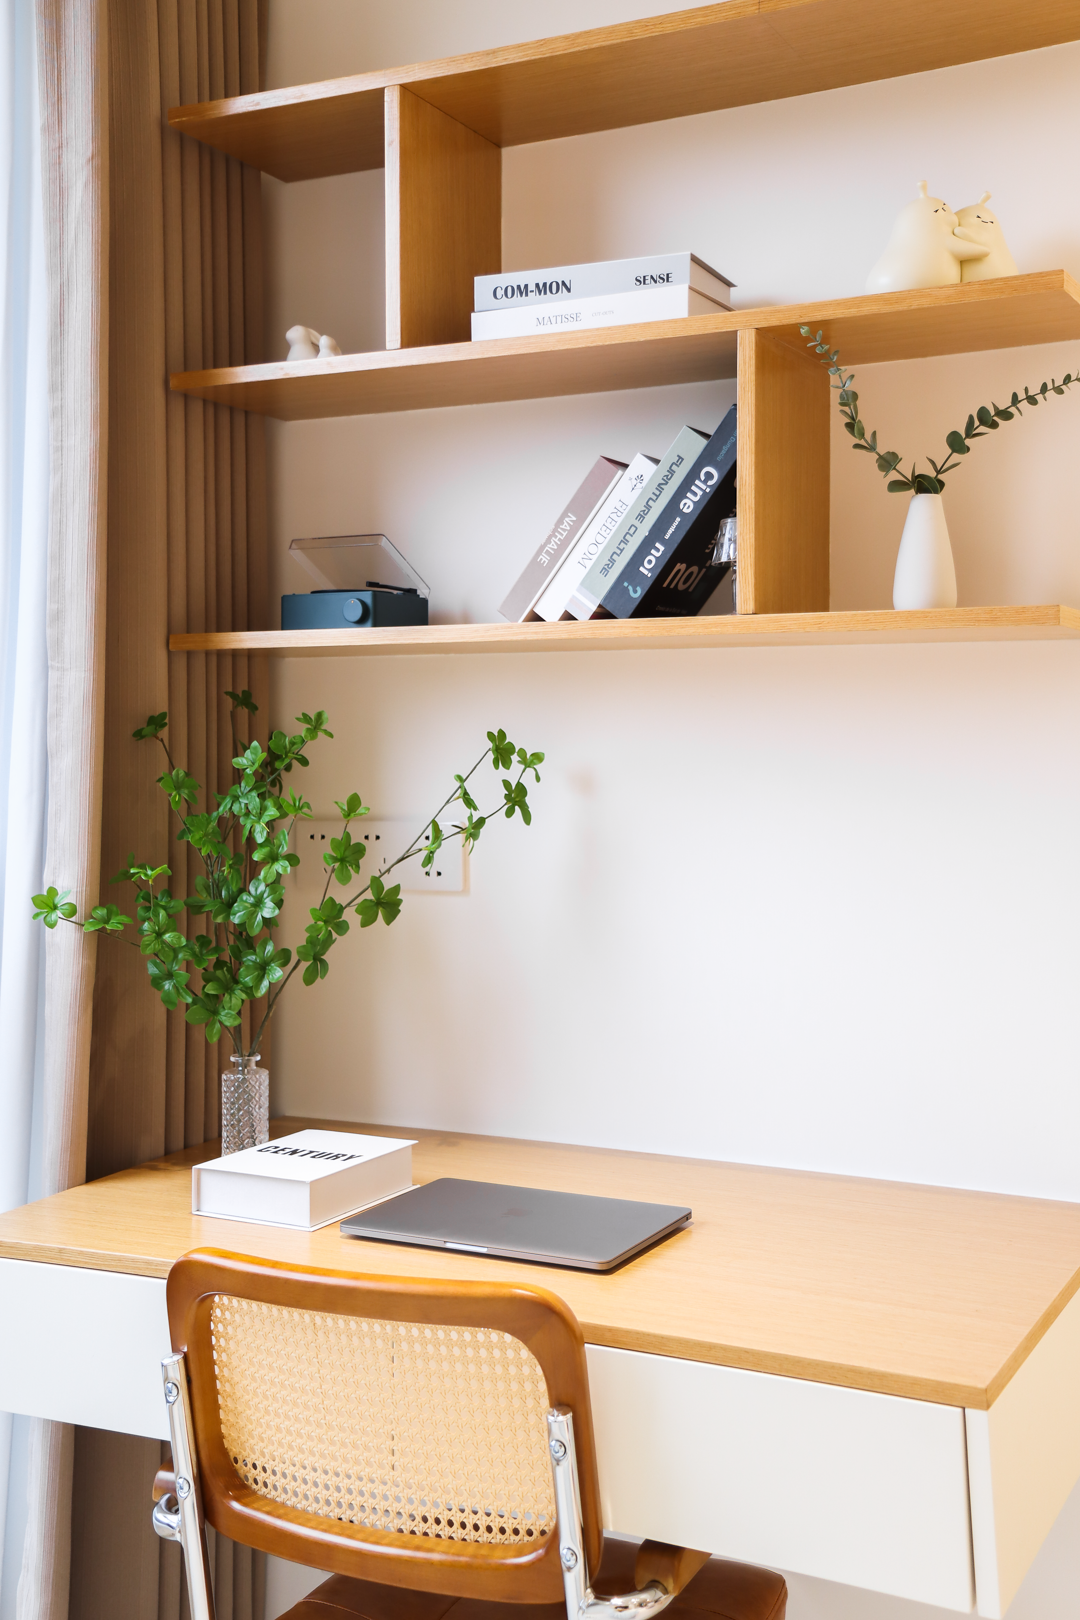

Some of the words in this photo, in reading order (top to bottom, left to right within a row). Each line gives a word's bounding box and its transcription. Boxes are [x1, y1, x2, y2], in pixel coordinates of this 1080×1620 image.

[492, 279, 572, 301] COM-MON
[634, 272, 673, 287] SENSE
[535, 312, 582, 327] MATISSE
[635, 454, 685, 524] FURNITURE
[680, 466, 718, 513] Cine
[537, 512, 577, 567] NATHALIE
[577, 499, 629, 569] FREEDOM
[599, 524, 639, 578] CULTURE
[639, 542, 665, 578] noi
[662, 560, 711, 592] noi
[623, 581, 641, 598] ?
[256, 1145, 363, 1162] CENTURY
